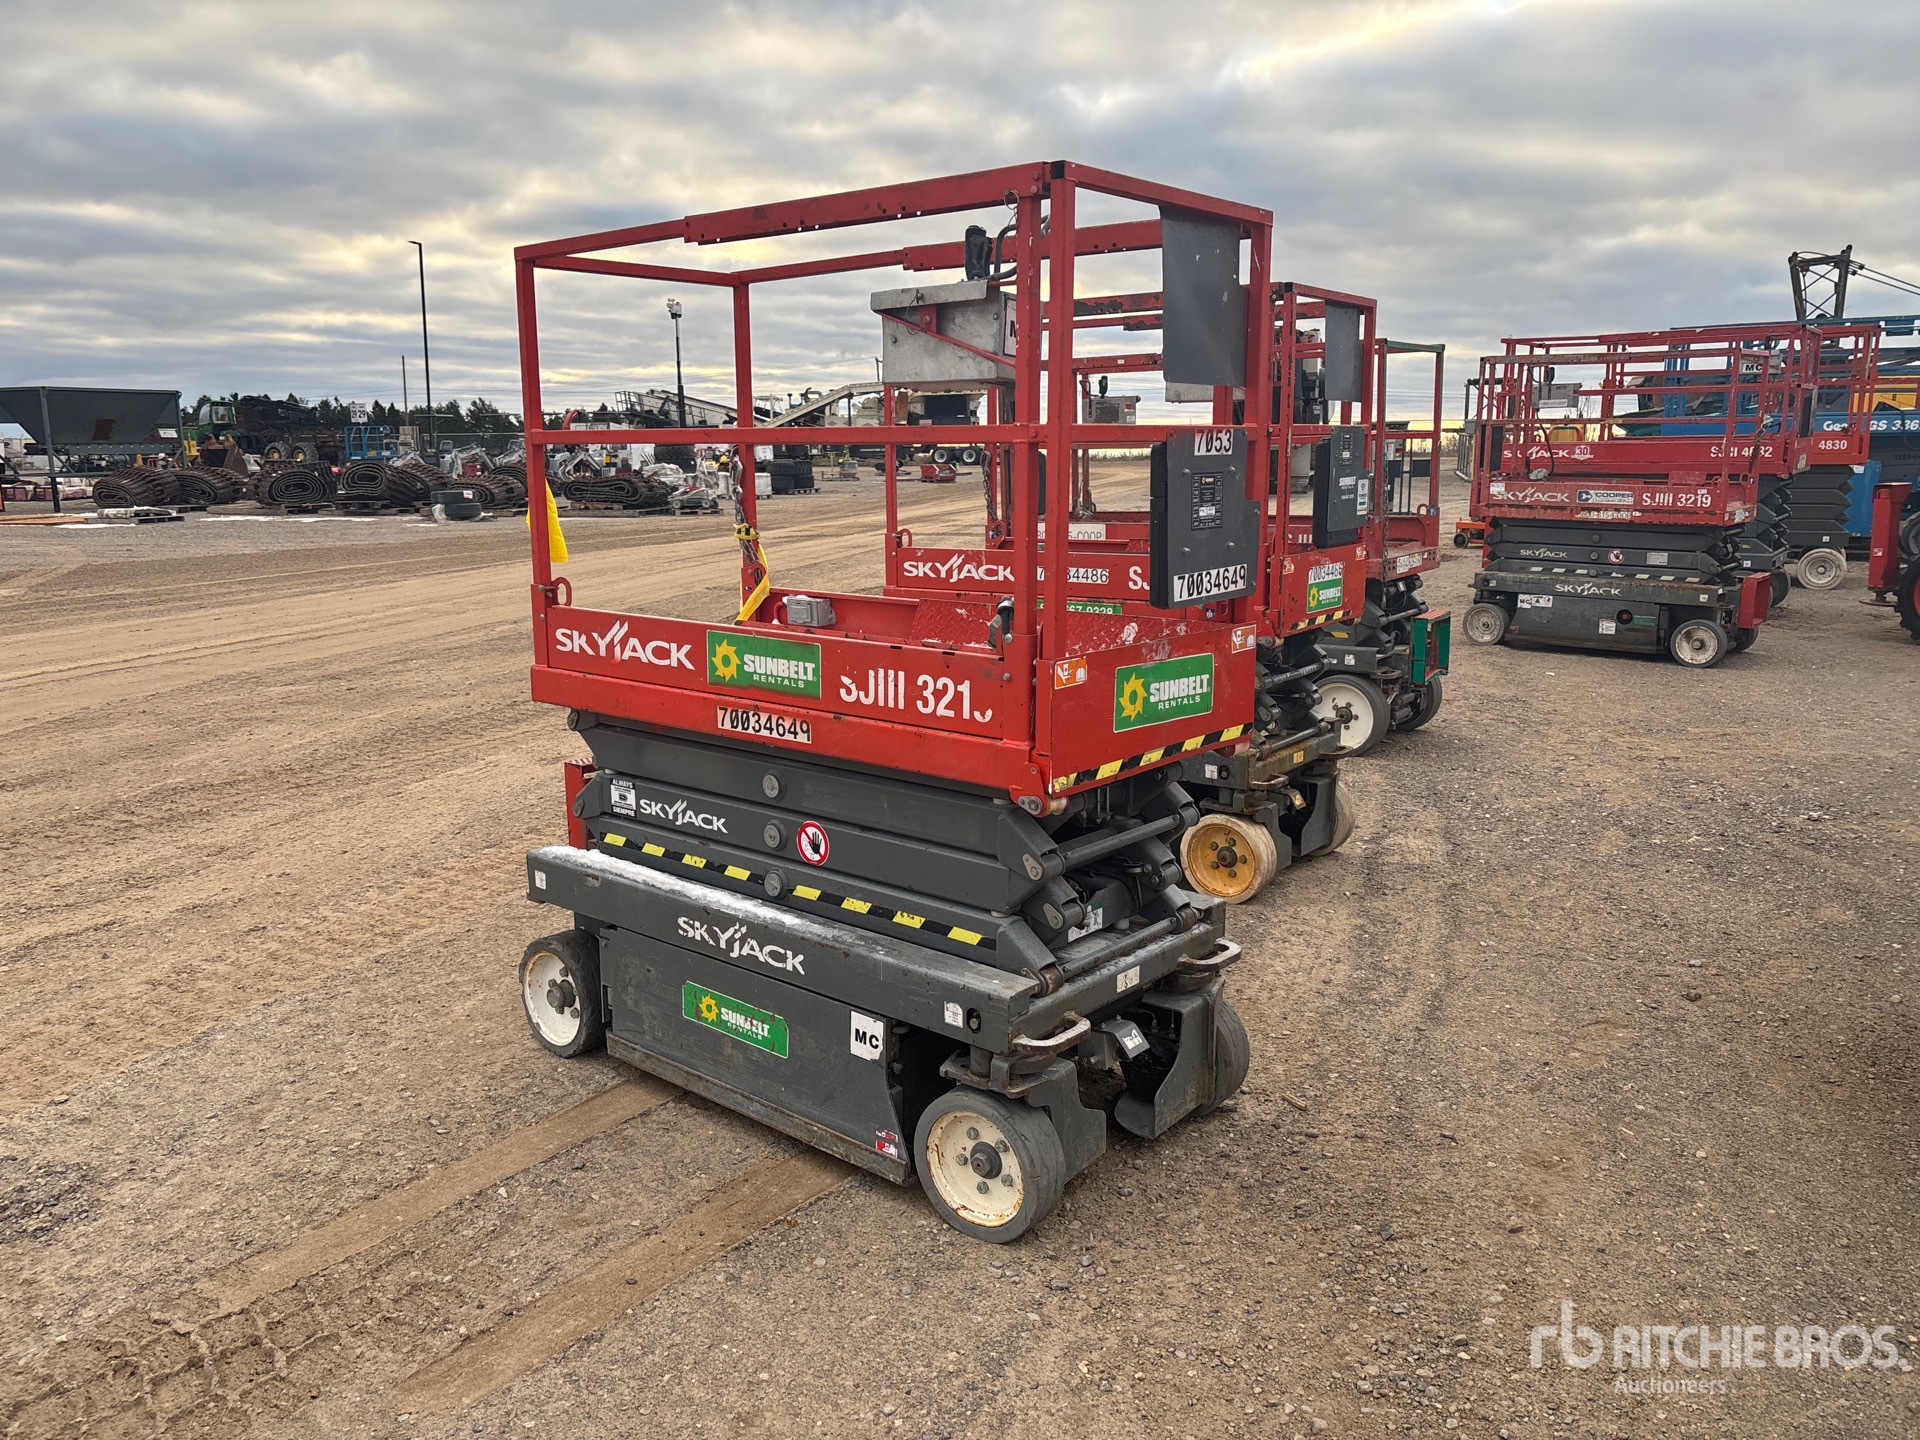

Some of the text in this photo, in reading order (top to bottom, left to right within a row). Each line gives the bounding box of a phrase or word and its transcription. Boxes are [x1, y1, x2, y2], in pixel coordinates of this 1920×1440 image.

[1745, 364, 1763, 372] MC
[1870, 420, 1888, 431] GS
[1891, 419, 1920, 431] 336
[1196, 429, 1232, 454] 7053
[1818, 440, 1847, 450] 4830
[1576, 446, 1589, 456] 30
[1594, 491, 1634, 499] COOPER
[1678, 494, 1712, 508] 3219
[1519, 547, 1568, 559] SKYJACK
[903, 553, 1015, 583] SKYJACK
[1038, 566, 1109, 584] 734486
[1177, 565, 1246, 600] 70034649
[1555, 582, 1622, 597] SKYJACK
[1319, 586, 1342, 601] SUNBELT
[554, 619, 696, 671] SKYJACK
[743, 654, 816, 682] SUNBELT
[753, 673, 805, 689] RENTALS
[1150, 673, 1210, 703] SUNBELT
[1158, 694, 1201, 711] RENTALS
[717, 706, 811, 742] 70034649
[612, 778, 634, 789] ALWAYS
[612, 805, 635, 817] SIEMPRE
[639, 798, 729, 835] SKYJACK
[677, 915, 805, 976] SKYJACK
[720, 1006, 771, 1038] SUNBELT
[854, 1028, 880, 1050] MC
